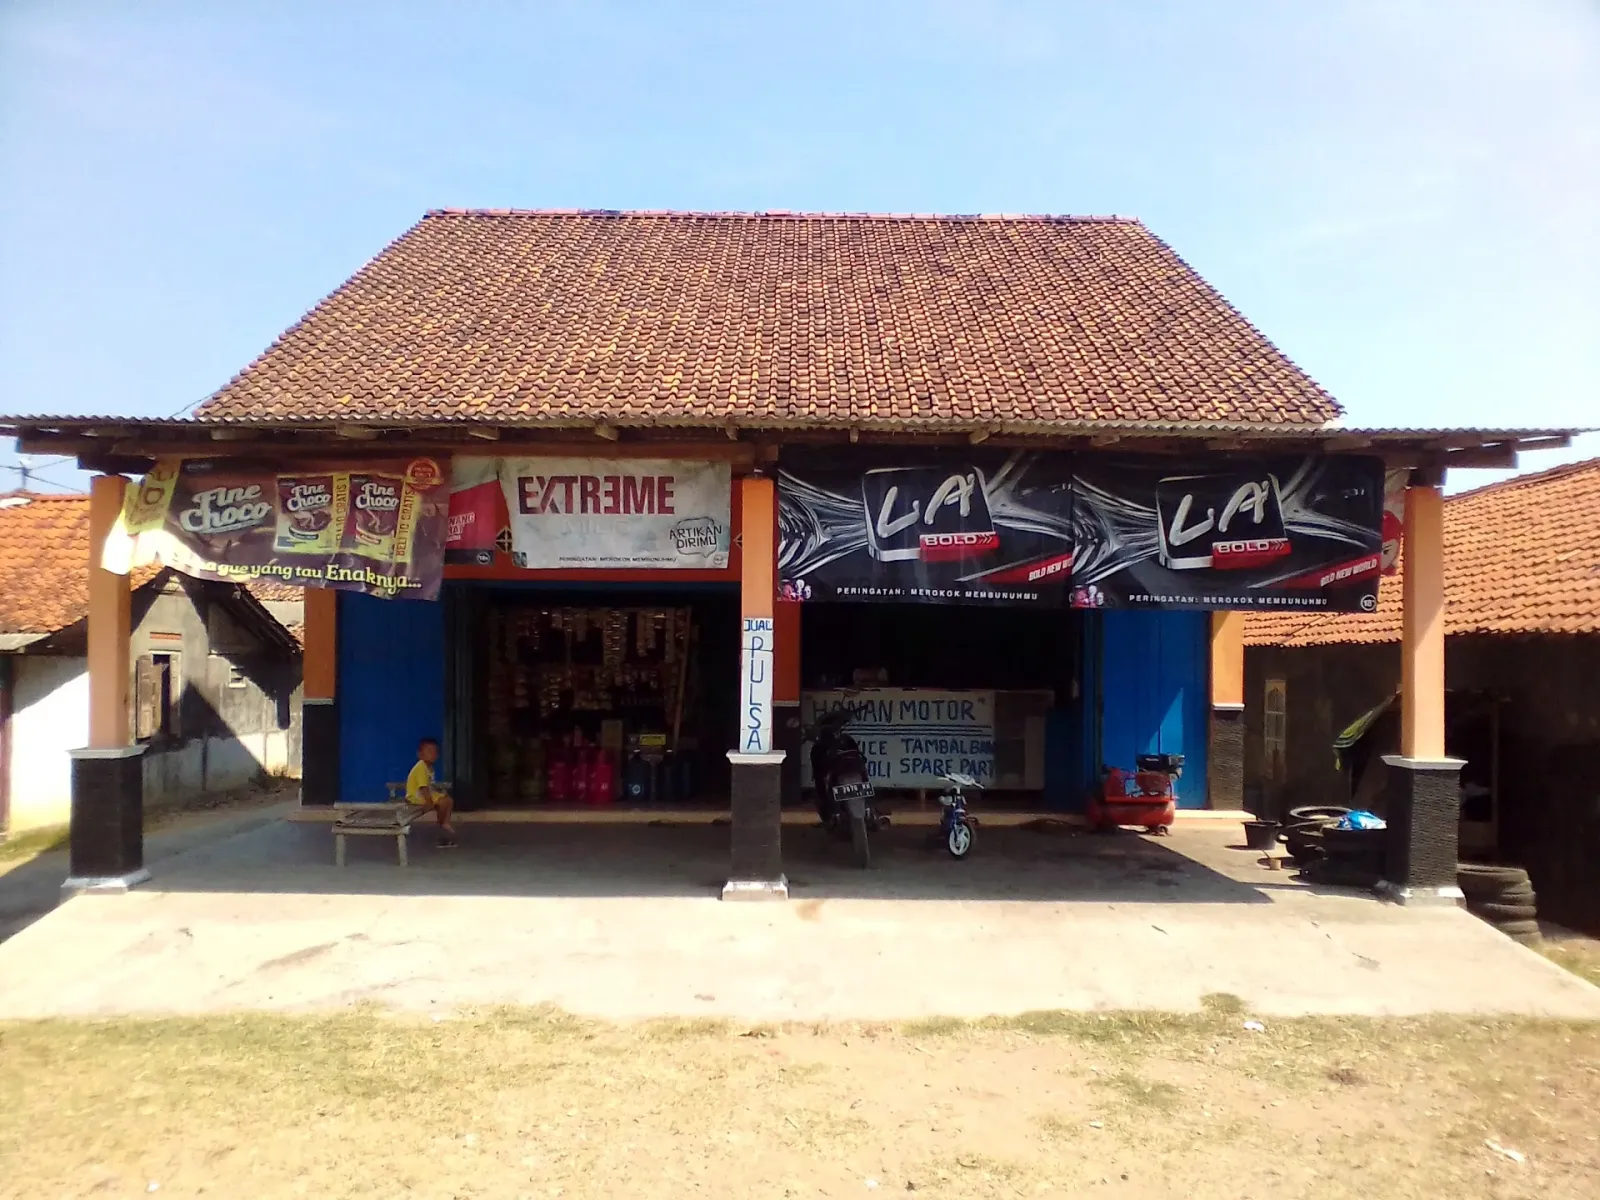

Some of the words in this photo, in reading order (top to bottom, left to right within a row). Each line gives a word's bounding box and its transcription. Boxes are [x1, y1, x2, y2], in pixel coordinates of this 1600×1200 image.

[356, 494, 399, 509] Choco
[517, 475, 675, 514] EXTREME
[287, 494, 332, 511] Choco
[180, 502, 273, 531] Choco
[669, 525, 722, 540] ARTIKAN
[925, 534, 978, 546] BOLD
[676, 536, 717, 549] DIRIMU
[1218, 542, 1269, 553] BOLD
[218, 564, 248, 576] gue
[250, 565, 292, 580] yang
[294, 566, 321, 578] tau
[910, 588, 960, 597] MEROKOK
[965, 590, 1038, 600] MEMBUNUHMU
[744, 619, 772, 631] JUAL
[747, 635, 764, 750] PULSA
[900, 758, 952, 776] SPARE
